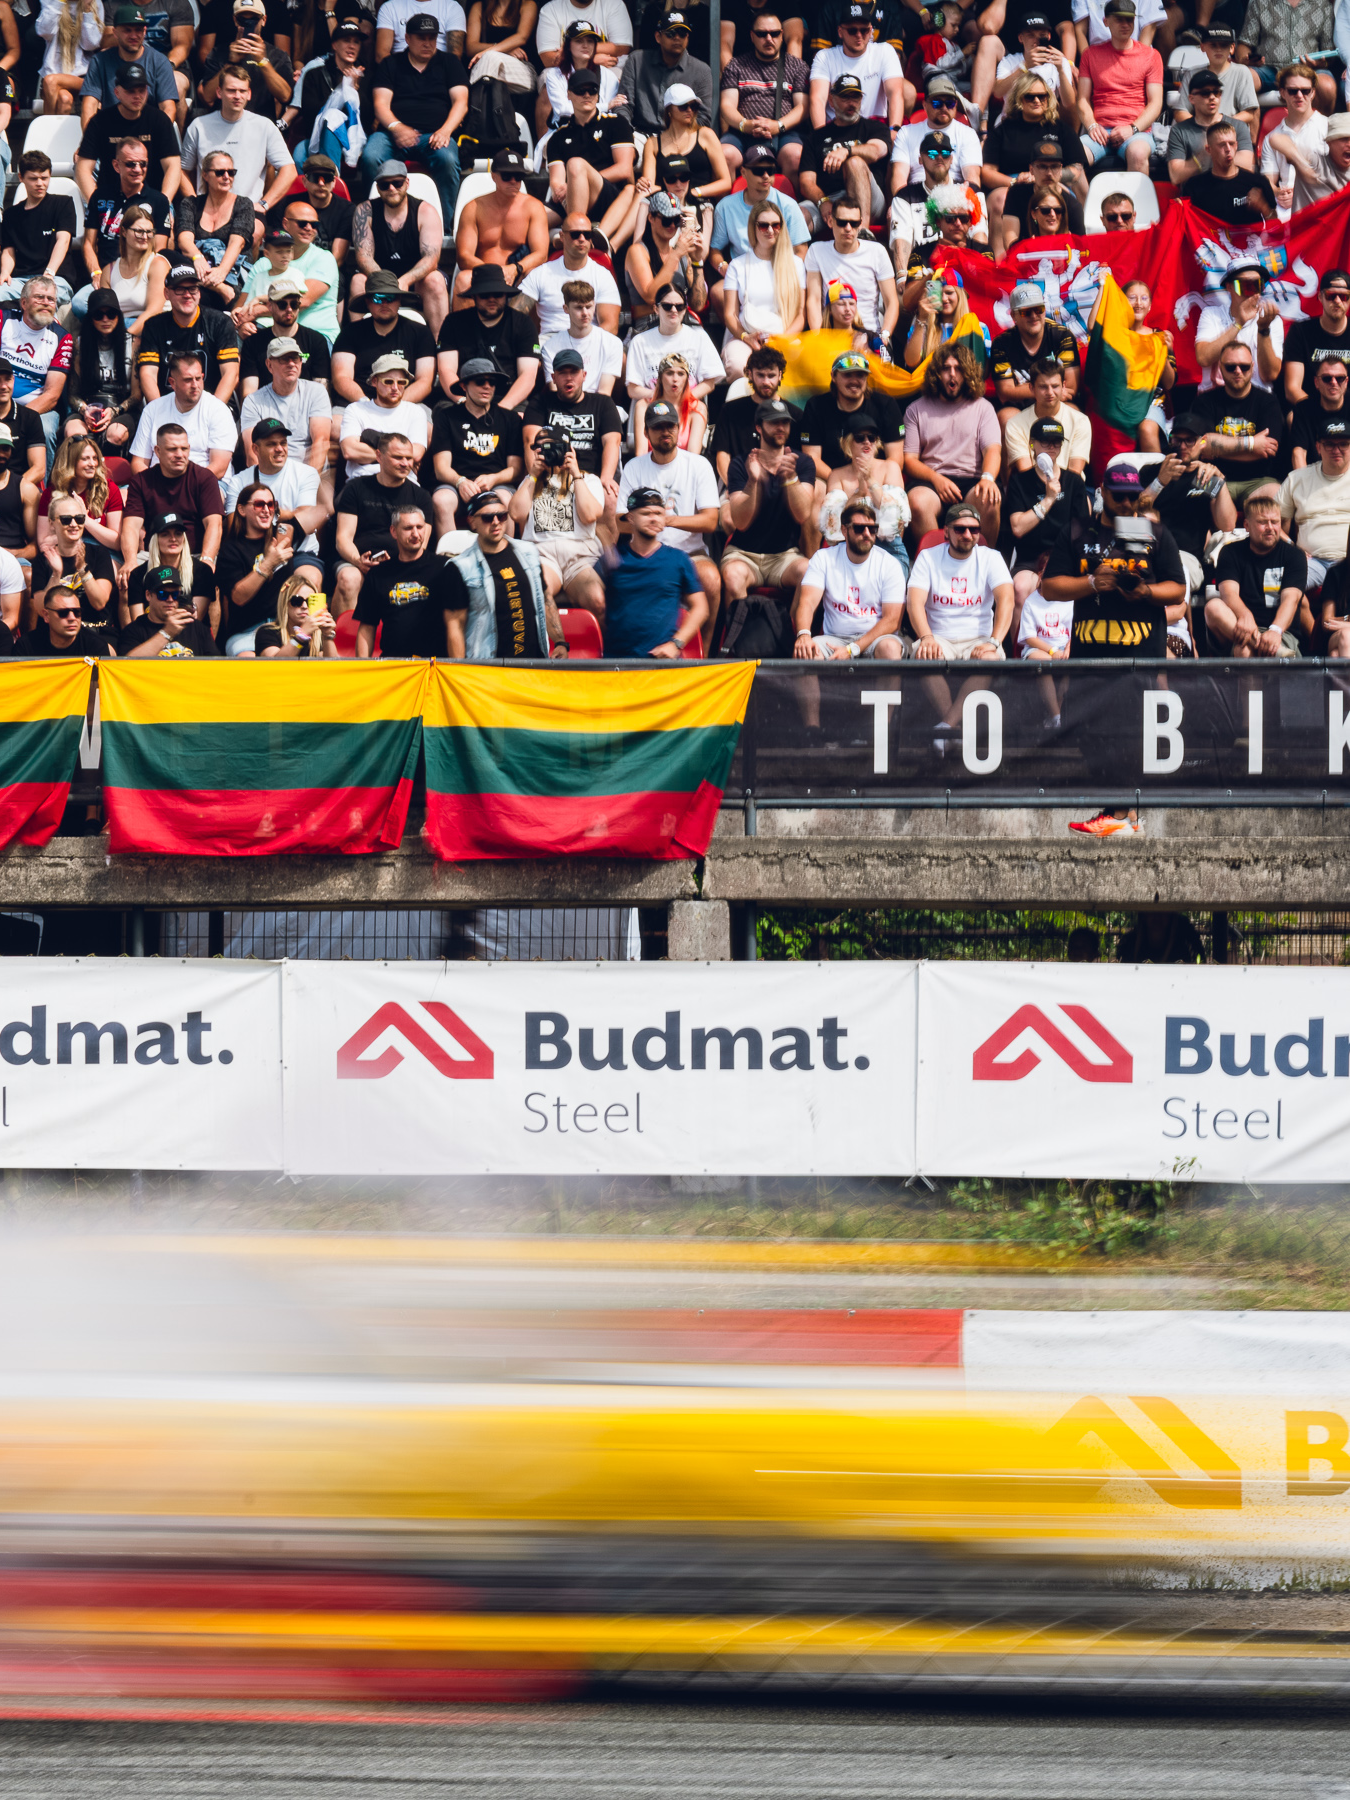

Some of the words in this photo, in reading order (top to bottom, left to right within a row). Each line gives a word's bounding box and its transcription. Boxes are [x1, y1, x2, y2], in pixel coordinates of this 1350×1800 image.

[98, 200, 115, 211] 36
[505, 581, 525, 656] LIETUVA
[832, 602, 878, 615] POLSKA
[933, 595, 982, 606] POLSKA
[860, 690, 1003, 774] TO
[524, 1010, 870, 1071] Budmat.
[524, 1092, 643, 1134] Steel
[1162, 1096, 1284, 1139] Steel
